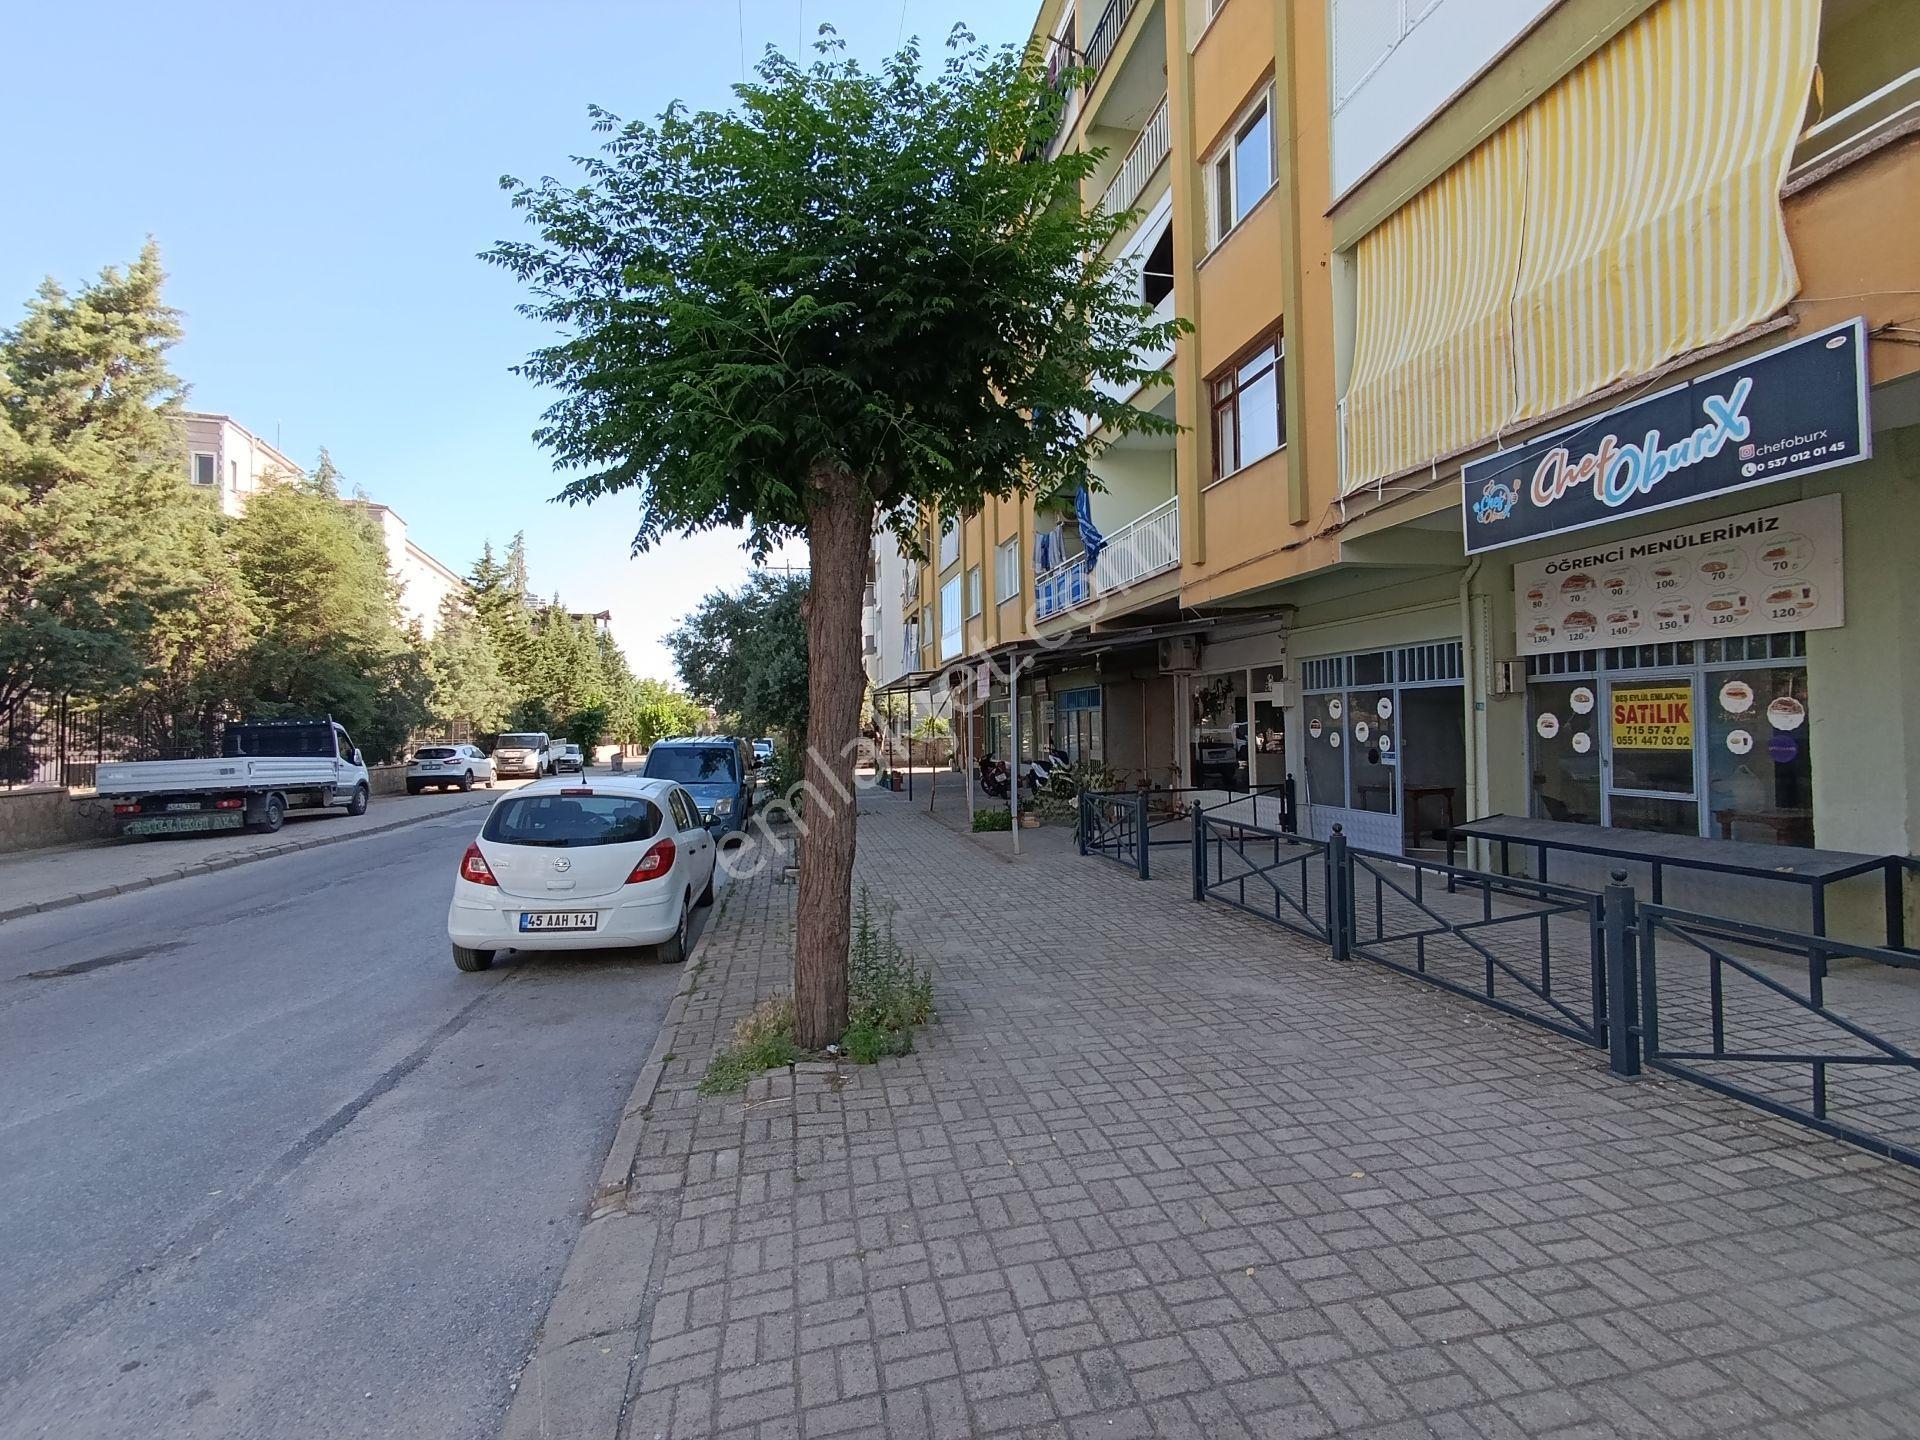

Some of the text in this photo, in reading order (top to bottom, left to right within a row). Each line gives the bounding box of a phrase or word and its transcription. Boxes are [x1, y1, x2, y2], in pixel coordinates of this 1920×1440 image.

[1756, 429, 1828, 456] chefoburx
[1767, 457, 1787, 469] 537
[1790, 451, 1811, 462] 012
[1813, 446, 1827, 456] 01
[1829, 441, 1846, 452] 45
[1545, 517, 1780, 575] ÖĞRENCİ MENÜLERİMİZ
[1772, 560, 1788, 571] 70
[1711, 571, 1726, 580] 70
[1656, 580, 1675, 589] 100
[1611, 588, 1623, 596] 90
[1570, 594, 1580, 602] 70
[1772, 607, 1796, 619] 120
[1712, 614, 1734, 624] 120
[1659, 621, 1677, 630] 150
[1611, 627, 1628, 636] 140
[1569, 633, 1584, 641] 120
[1626, 726, 1677, 734] 715 57 47
[1616, 736, 1690, 745] 0551 447 03 02
[528, 914, 593, 927] 45 AAH 141
